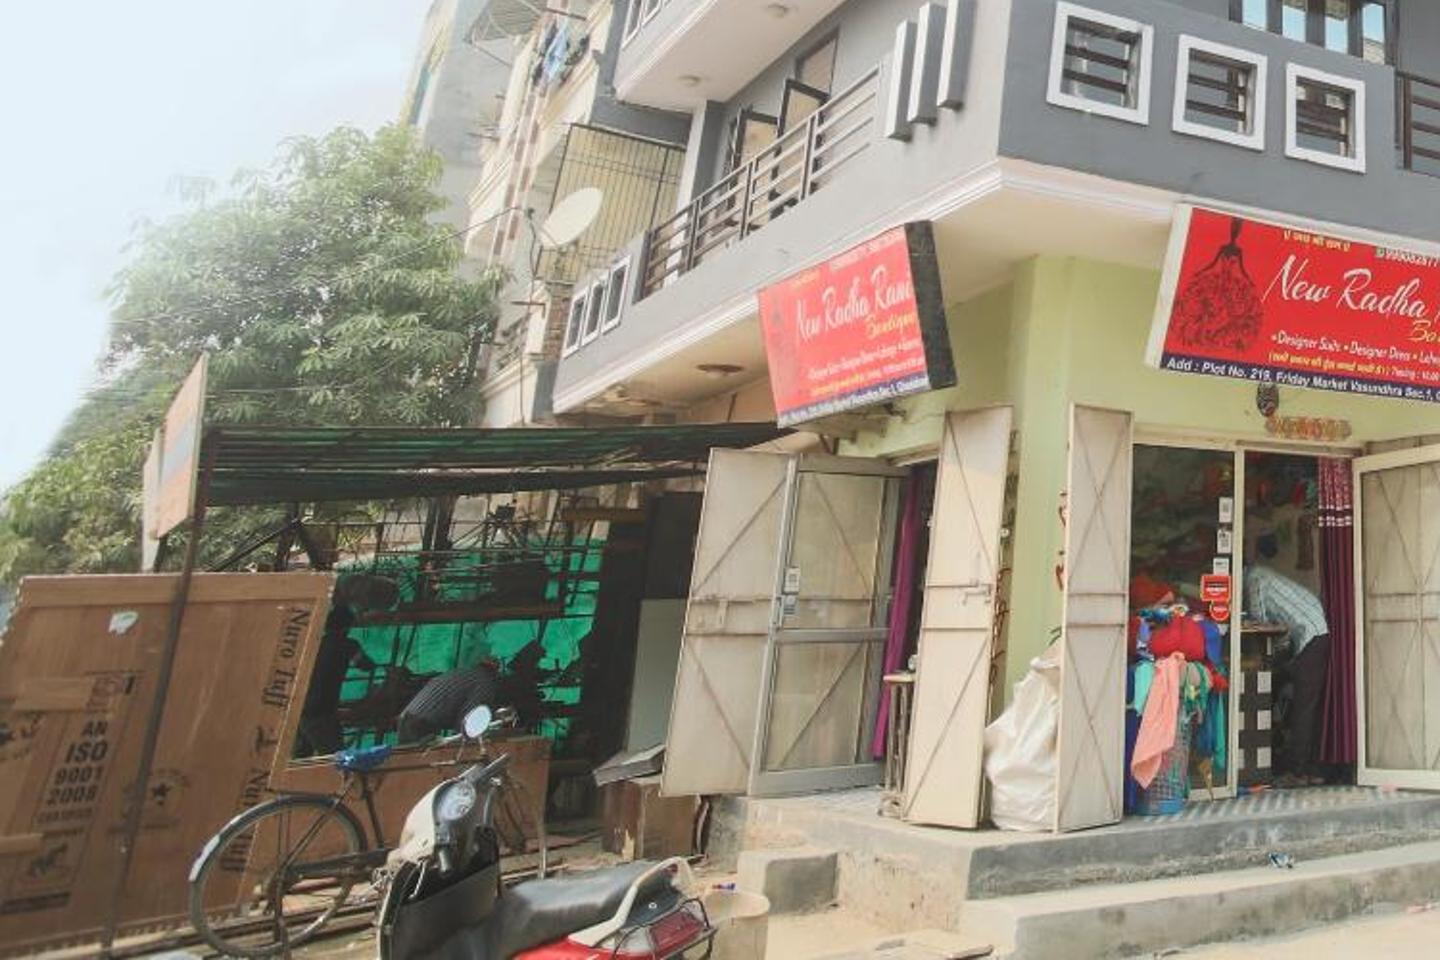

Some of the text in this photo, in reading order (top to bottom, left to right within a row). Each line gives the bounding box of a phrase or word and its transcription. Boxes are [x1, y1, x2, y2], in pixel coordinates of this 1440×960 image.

[1259, 254, 1330, 303] New
[1336, 268, 1426, 319] Radha
[822, 277, 869, 332] Radha
[1277, 330, 1319, 352] Designer
[1350, 341, 1388, 359] Designer
[1202, 362, 1225, 376] Plot
[1228, 366, 1247, 378] No.
[1276, 371, 1311, 387] Friday
[1313, 376, 1348, 390] Market
[65, 740, 108, 764] ISO
[54, 766, 104, 786] 9001
